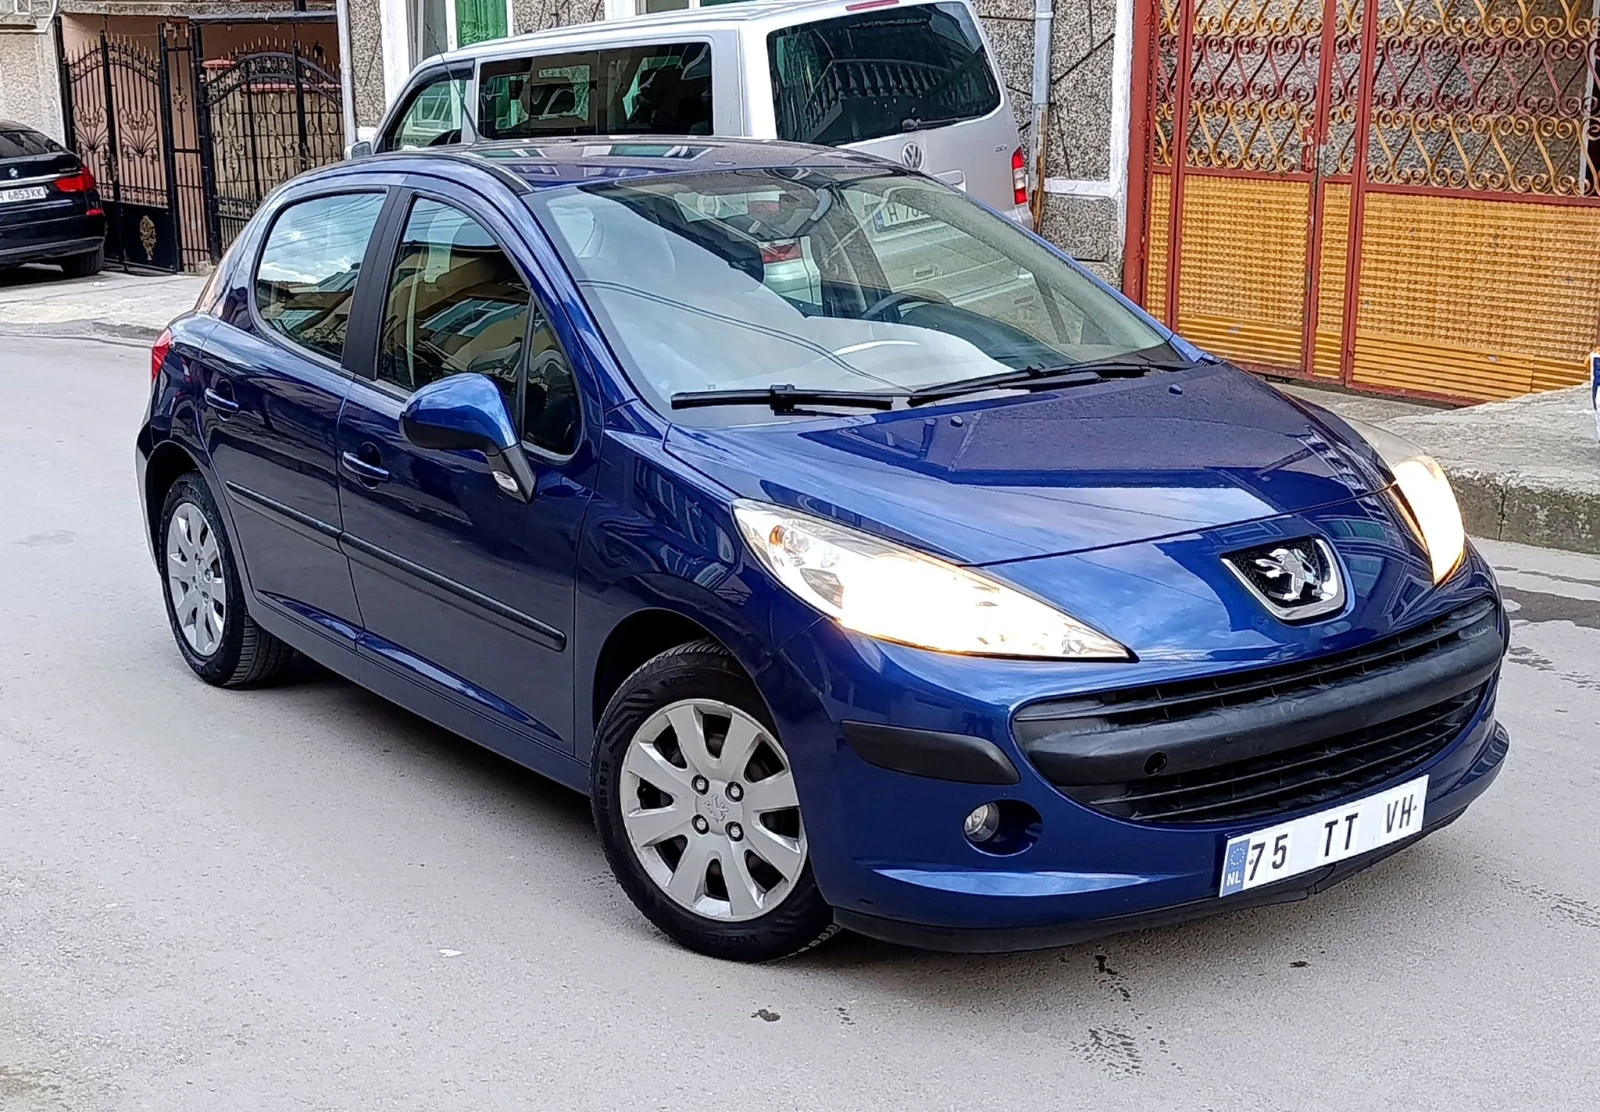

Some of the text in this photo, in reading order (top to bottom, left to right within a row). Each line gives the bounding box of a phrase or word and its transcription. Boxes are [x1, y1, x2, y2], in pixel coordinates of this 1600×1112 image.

[1248, 794, 1414, 881] 75 TT VH
[1226, 872, 1241, 886] NL
